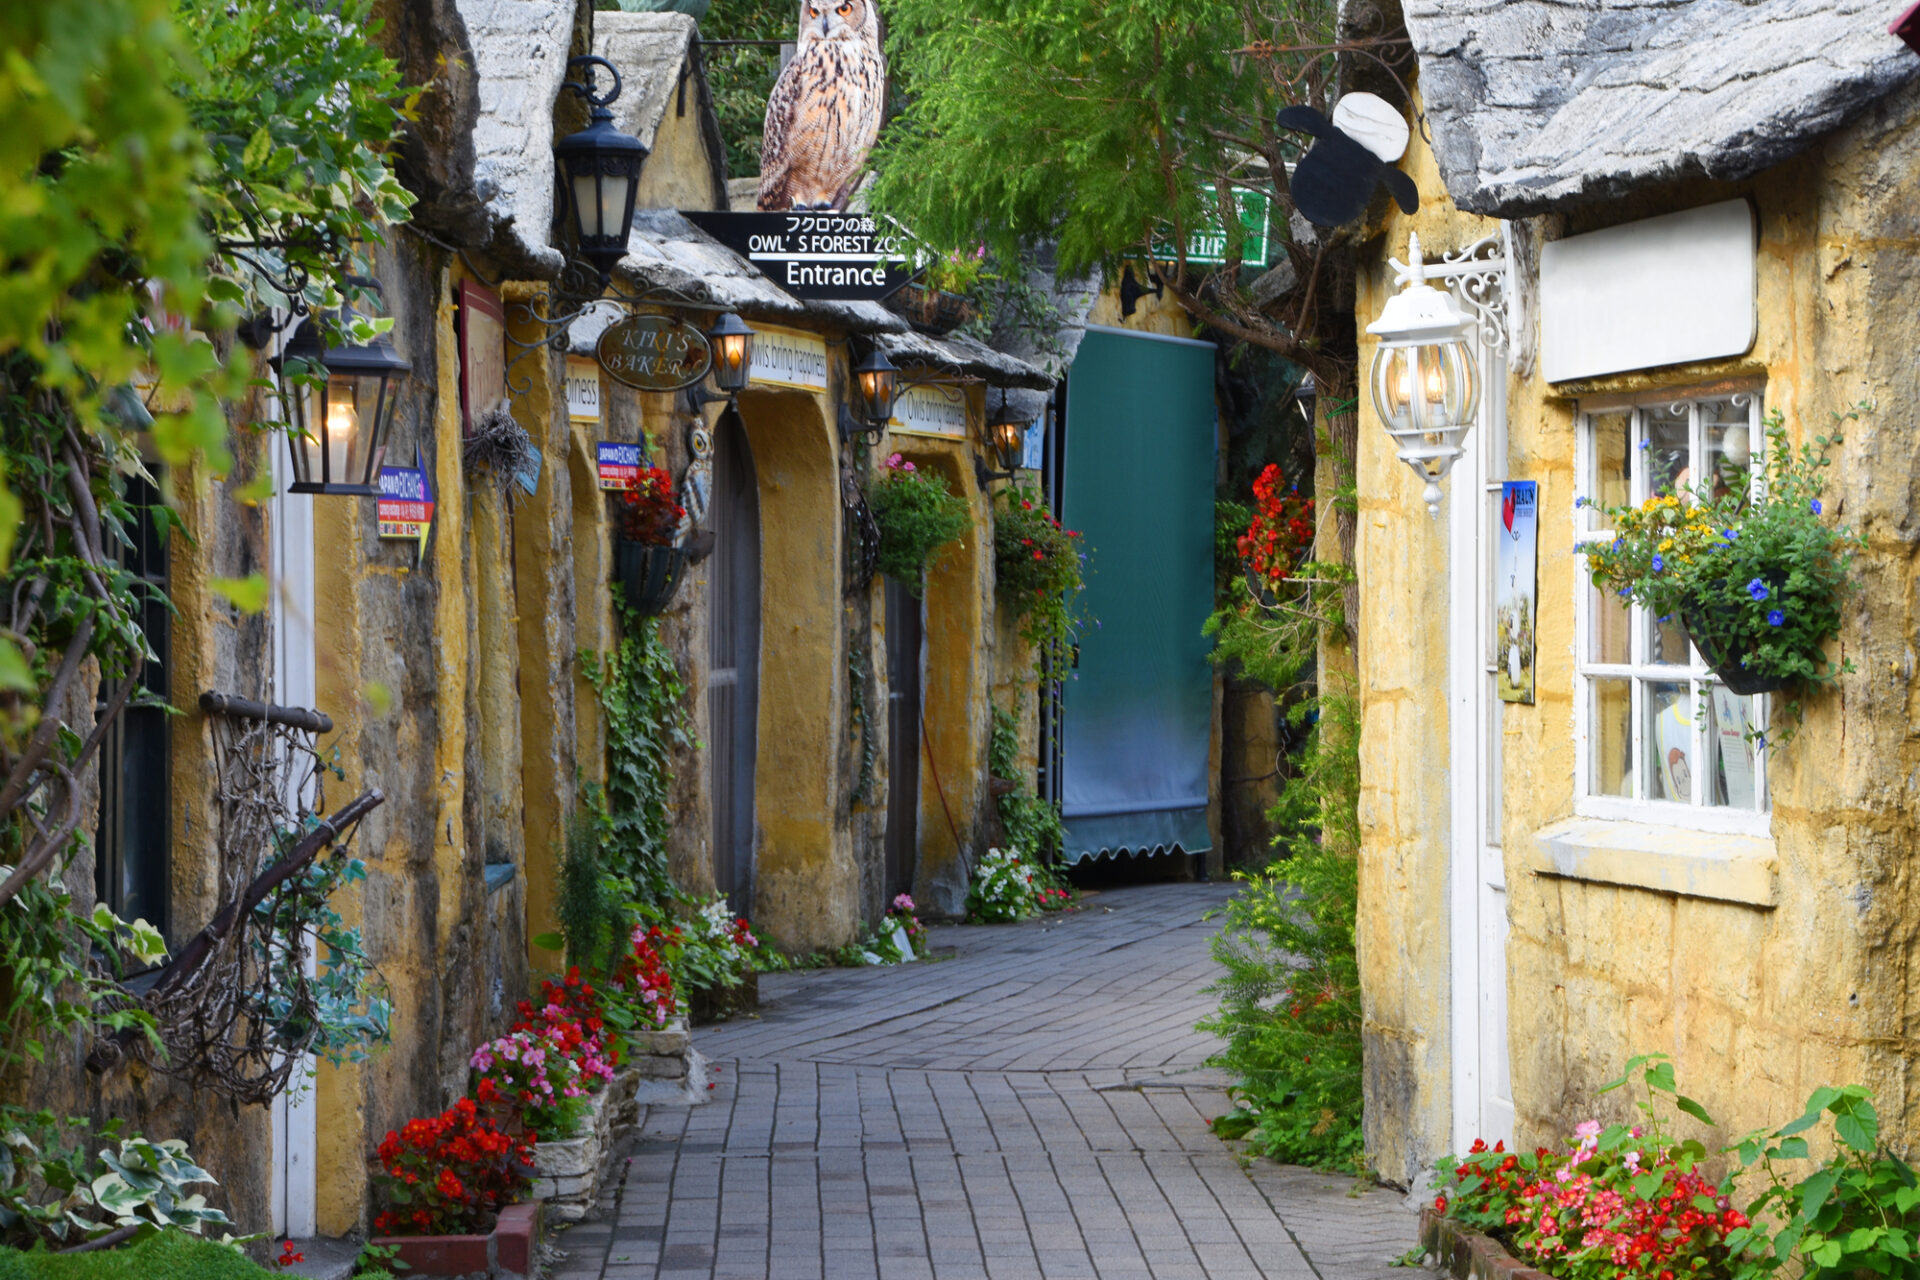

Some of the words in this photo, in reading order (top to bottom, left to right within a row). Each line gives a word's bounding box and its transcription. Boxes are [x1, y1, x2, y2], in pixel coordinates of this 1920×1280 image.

[786, 216, 876, 233] フクロウの森
[811, 236, 871, 253] FOREST
[786, 261, 886, 287] Entrance
[622, 329, 691, 352] KIKI'S
[771, 335, 792, 380] bring
